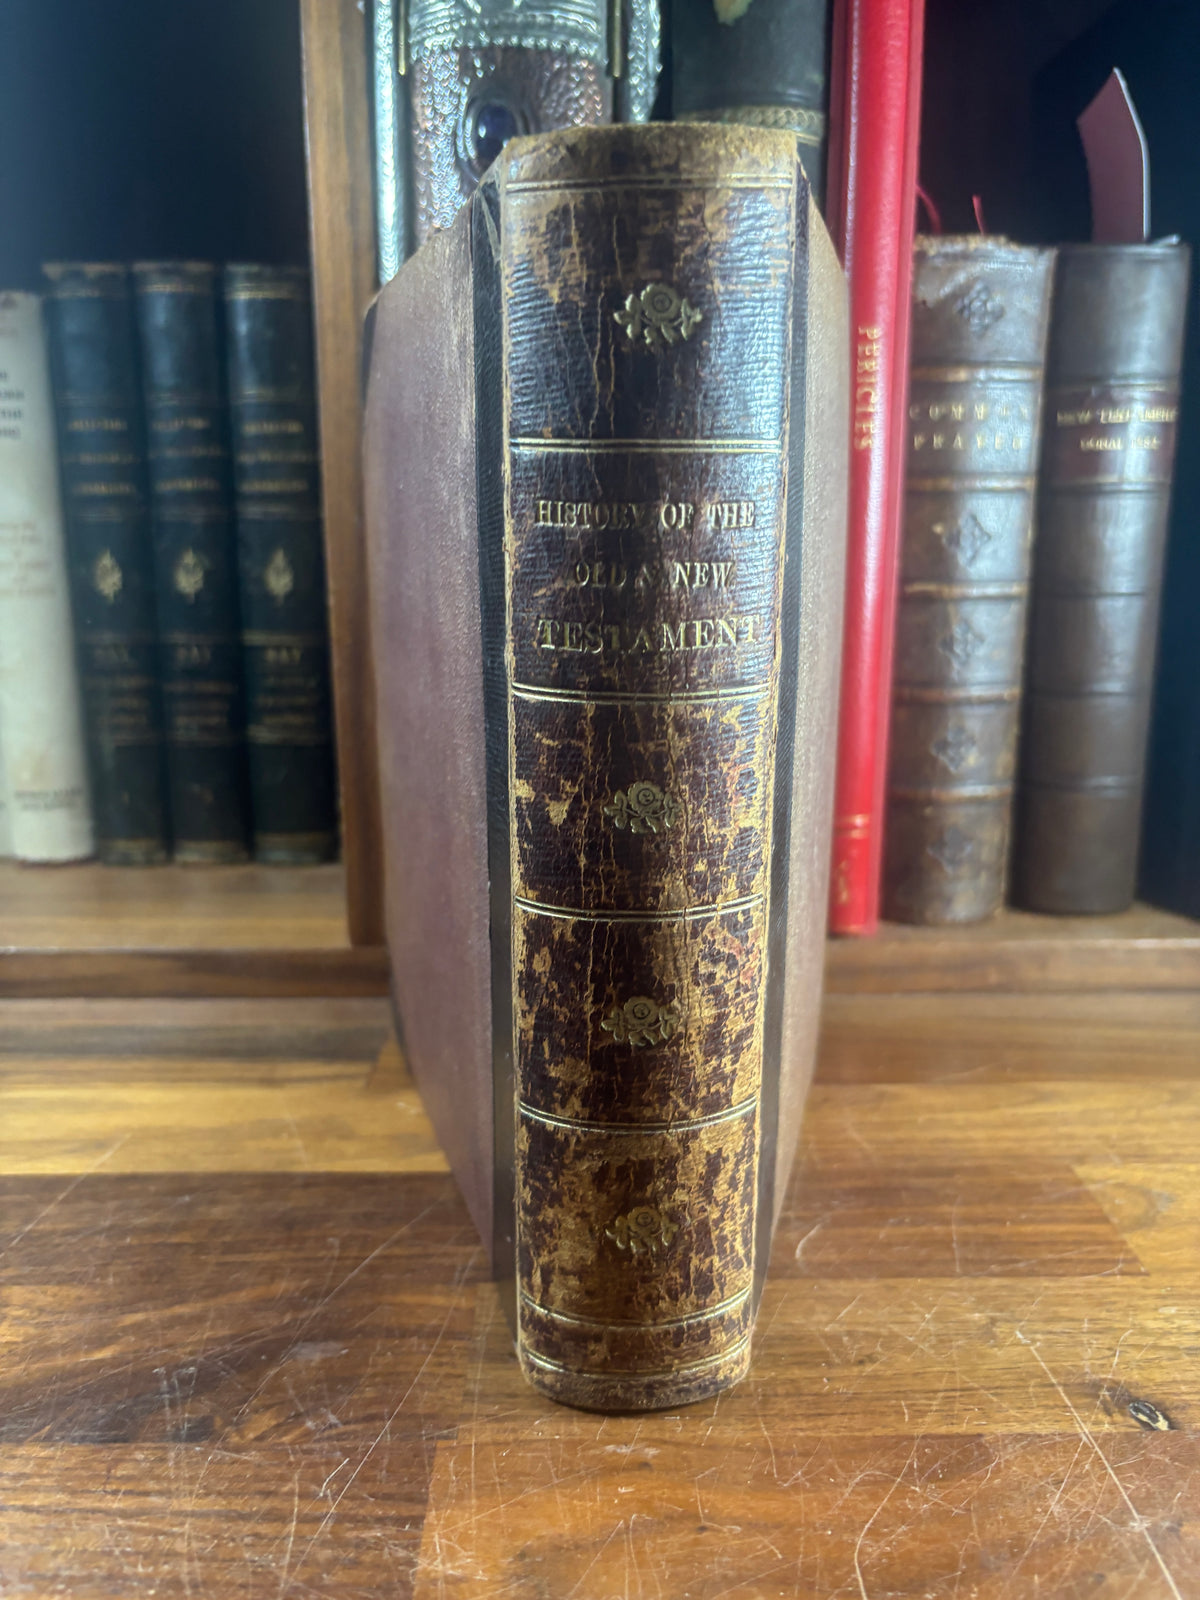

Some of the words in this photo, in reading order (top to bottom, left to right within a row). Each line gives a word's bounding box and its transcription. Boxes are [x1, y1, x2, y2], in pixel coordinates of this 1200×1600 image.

[661, 502, 695, 529] OF
[707, 501, 756, 528] THE
[575, 561, 628, 588] OLD
[673, 562, 736, 588] NEW
[537, 614, 761, 654] TESTAMENT
